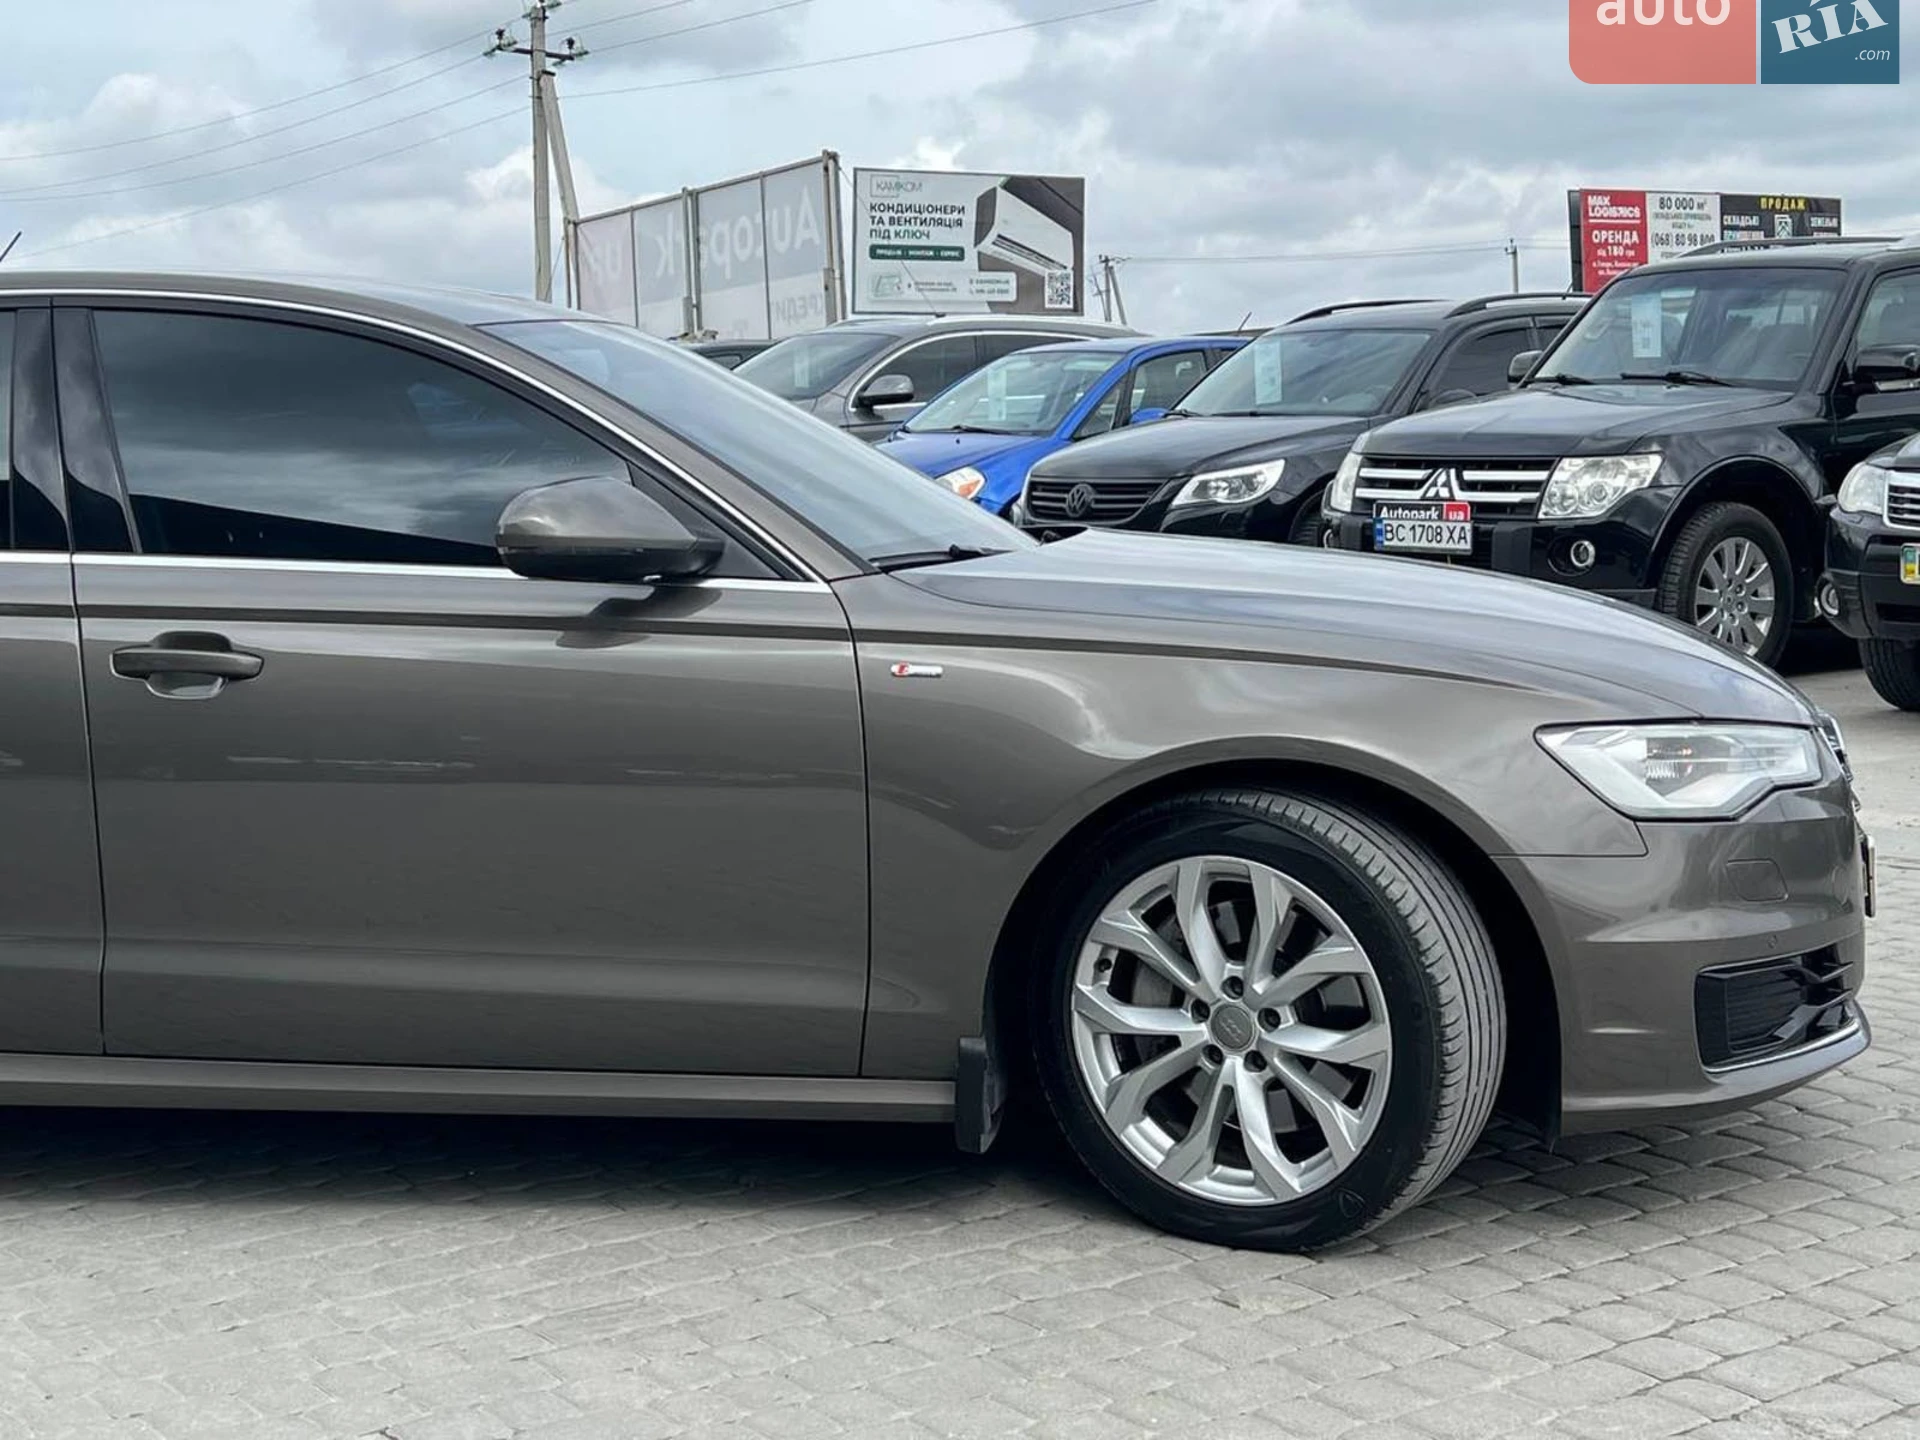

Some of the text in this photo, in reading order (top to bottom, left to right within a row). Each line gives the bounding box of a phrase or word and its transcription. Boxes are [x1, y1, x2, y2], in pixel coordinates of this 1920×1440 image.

[1587, 195, 1610, 206] MAX
[1659, 196, 1672, 210] 80
[1674, 196, 1694, 211] 000
[1760, 197, 1806, 211] ПРОДАЖ
[869, 202, 965, 215] КОНДИЦІОНЕРИ
[870, 216, 962, 228] ТА ВЕНТИЛЯЦІЯ
[870, 227, 930, 240] ПІД КЛЮЧ
[1592, 230, 1639, 246] ОРЕНДА
[1651, 232, 1674, 248] (068)
[1607, 246, 1624, 256] 180
[1380, 505, 1440, 519] Autopark
[1384, 524, 1467, 545] BC 1708 XA
